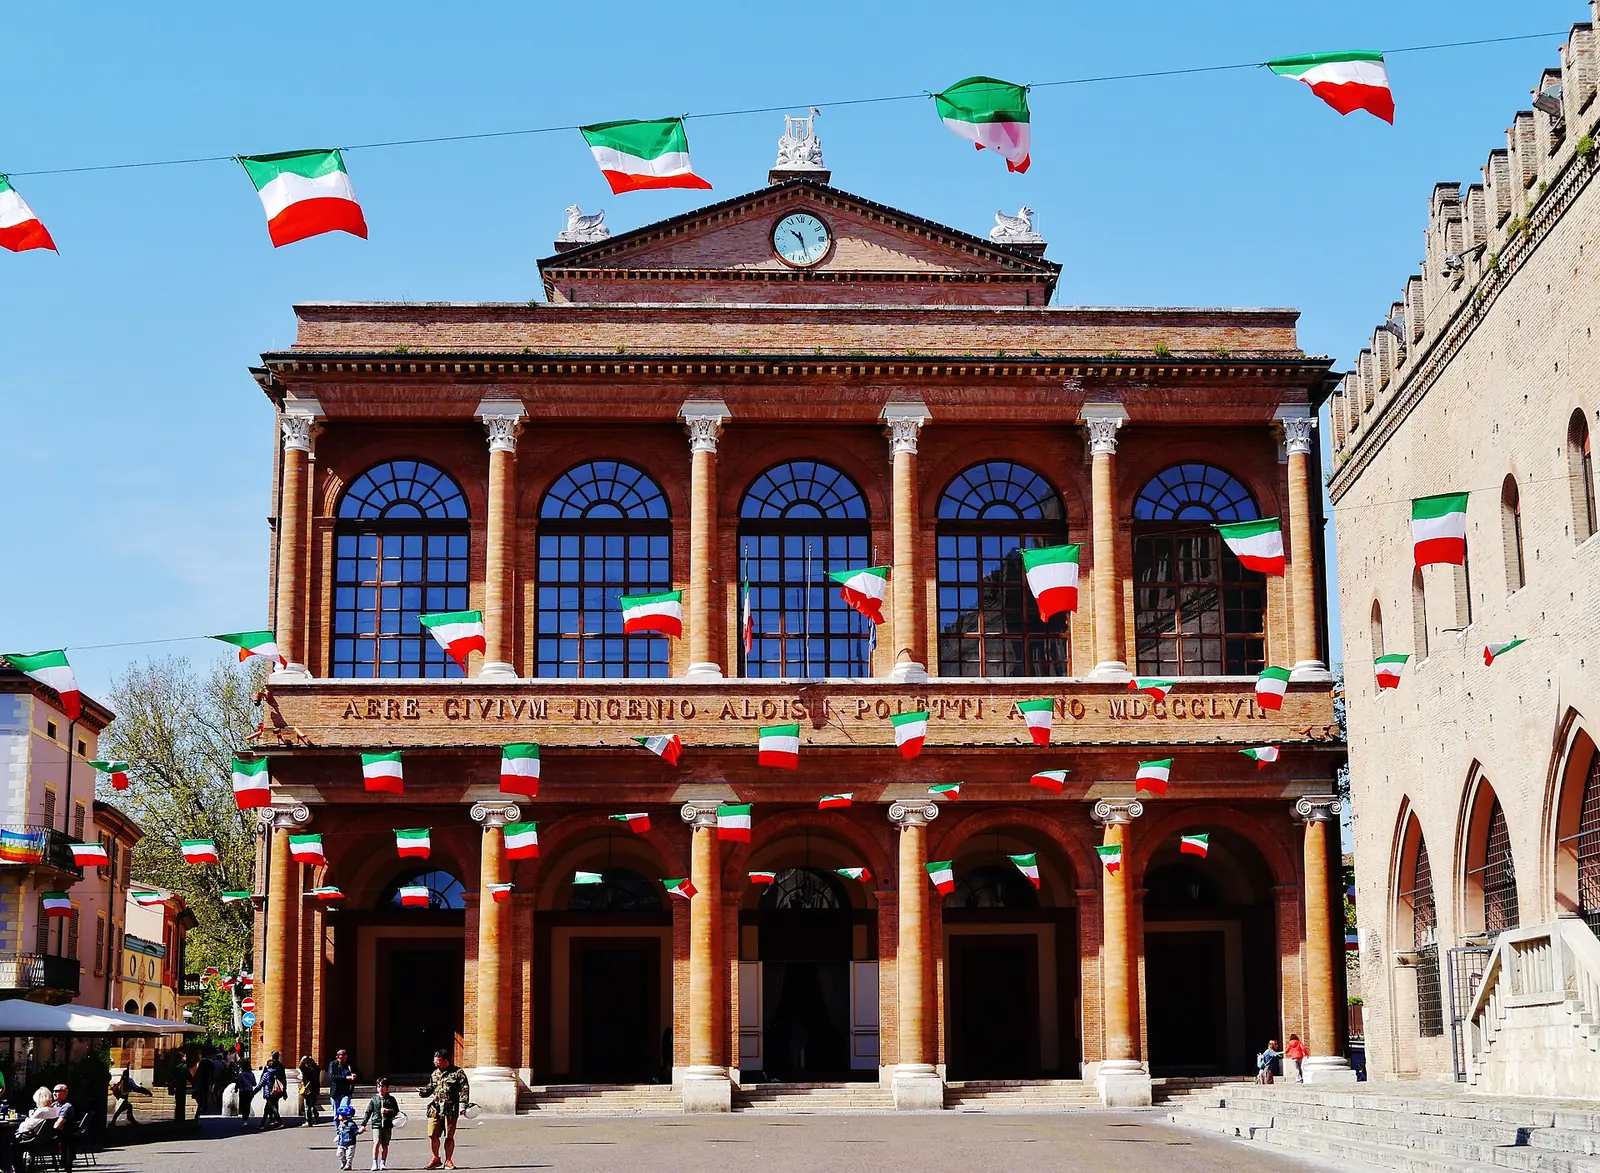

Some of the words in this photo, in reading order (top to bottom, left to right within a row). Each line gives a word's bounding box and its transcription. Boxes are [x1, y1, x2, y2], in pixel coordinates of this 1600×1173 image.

[342, 698, 420, 720] AERE
[443, 698, 550, 720] CIVIVM
[573, 698, 696, 720] INGENIO
[1006, 698, 1086, 721] ANO
